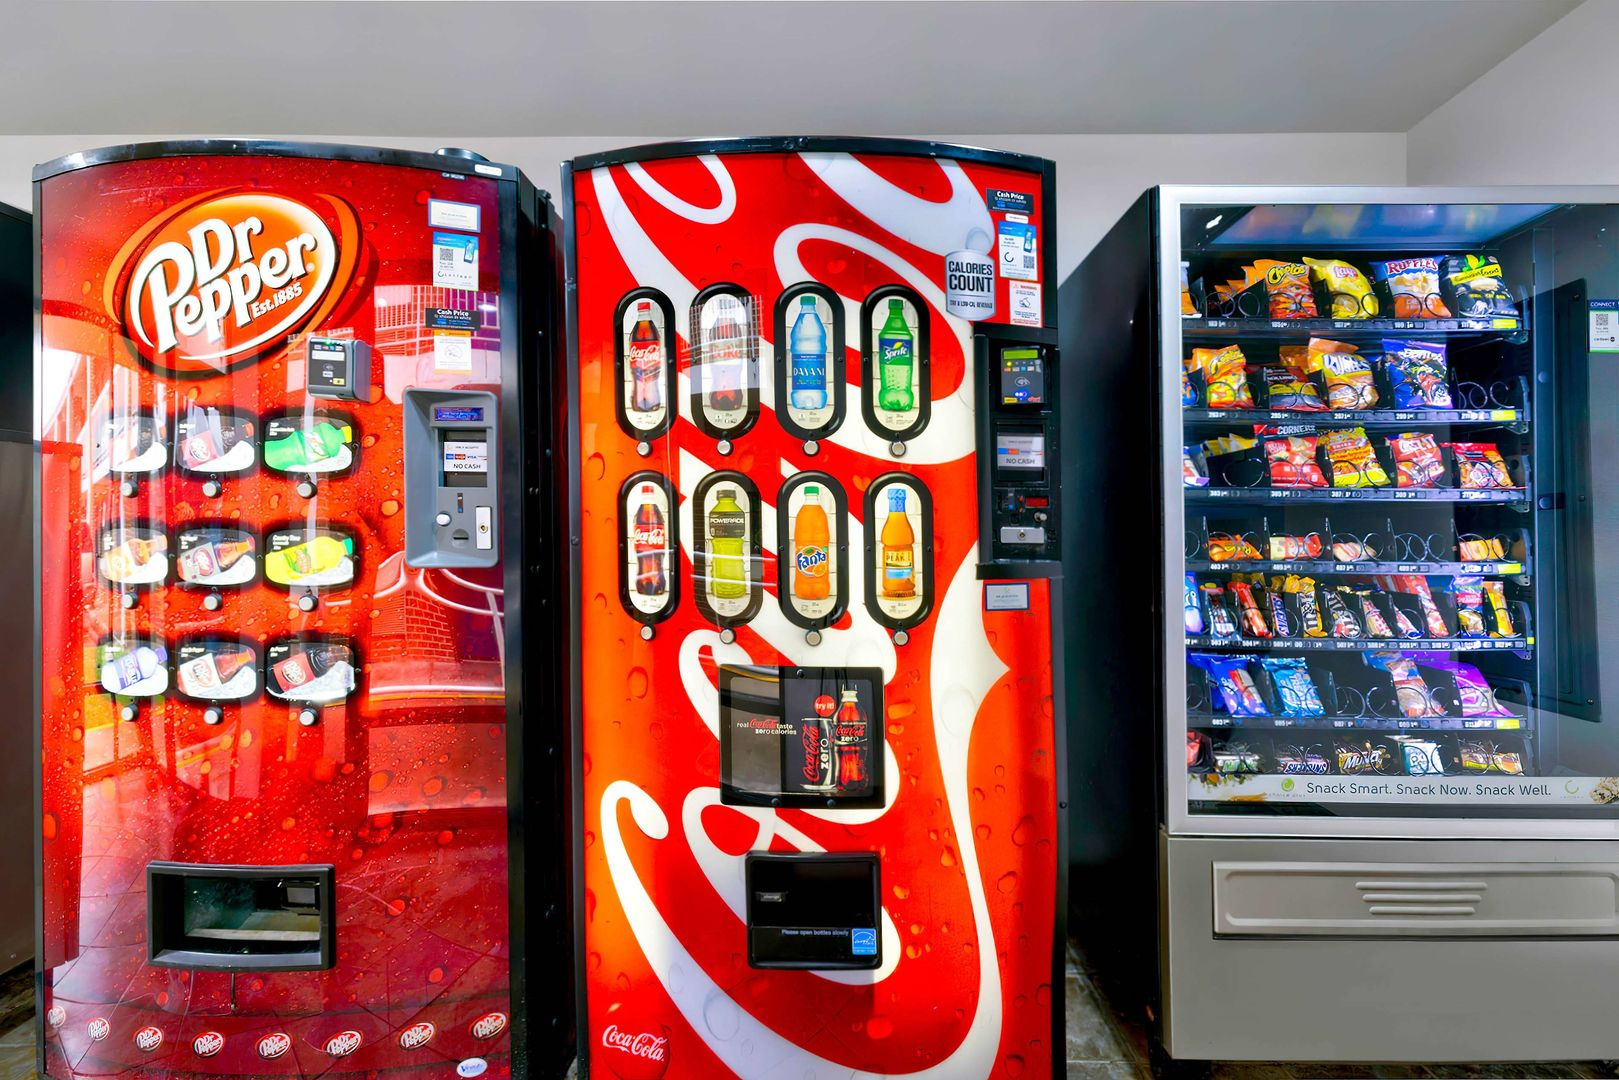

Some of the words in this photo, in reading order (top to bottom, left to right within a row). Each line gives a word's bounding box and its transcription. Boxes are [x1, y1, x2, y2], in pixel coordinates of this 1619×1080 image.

[188, 217, 261, 287] Dr
[949, 261, 993, 275] CALORIES
[949, 274, 993, 292] COUNT
[130, 233, 316, 354] Pepper
[885, 347, 909, 362] Sprite
[797, 550, 827, 570] Fanta
[816, 702, 827, 710] try
[802, 723, 819, 782] Coca-Cola
[820, 738, 829, 770] zero
[1307, 783, 1344, 795] Snack
[1350, 783, 1392, 796] Smart.
[1396, 785, 1435, 797] Snack
[1440, 785, 1471, 797] Now.
[1476, 785, 1514, 796] Snack
[1519, 785, 1551, 796] Well.
[473, 1018, 506, 1038] Pepper
[138, 1033, 161, 1049] Pepper
[196, 1038, 221, 1057] Pepper
[260, 1038, 289, 1057] Pepper
[328, 1037, 360, 1056] Pepper
[402, 1029, 435, 1049] Pepper
[602, 1024, 668, 1062] Coca-Cola
